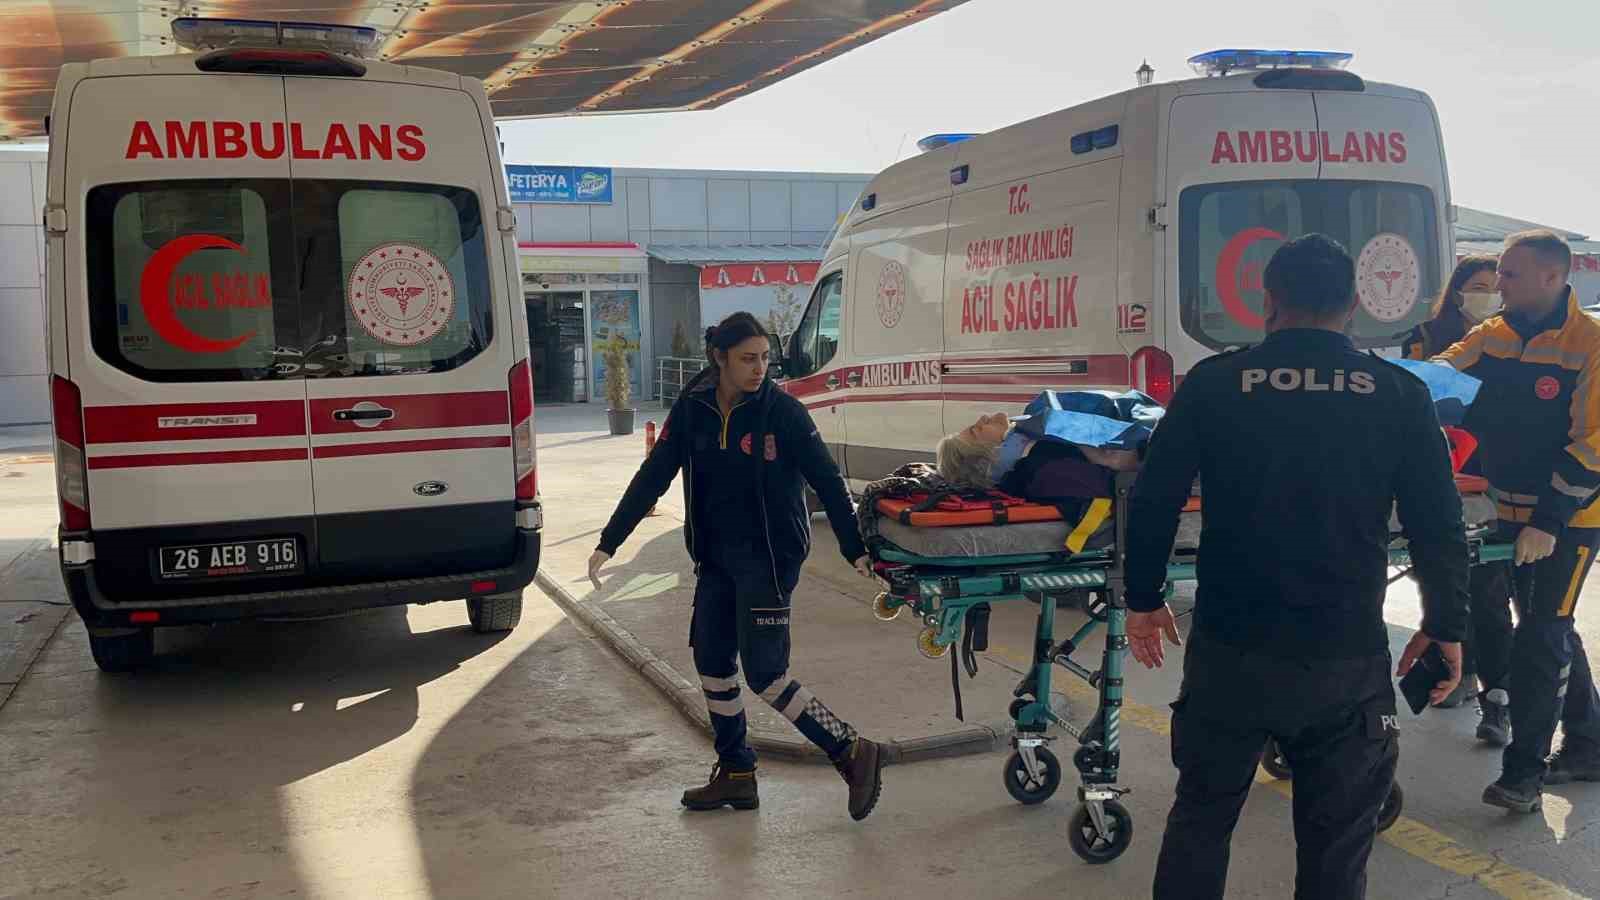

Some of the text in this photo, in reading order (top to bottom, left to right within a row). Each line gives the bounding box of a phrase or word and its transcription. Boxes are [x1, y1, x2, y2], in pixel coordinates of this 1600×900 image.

[125, 121, 426, 161] AMBULANS
[1211, 130, 1407, 163] AMBULANS
[1008, 184, 1031, 215] T.C.
[966, 224, 1074, 271] SAĞLIK BAKANLIĞI
[961, 272, 1079, 334] ACİL SAĞLIK
[1117, 303, 1147, 328] 112
[862, 360, 941, 386] AMBULANS
[174, 542, 294, 570] 26 AEB 916
